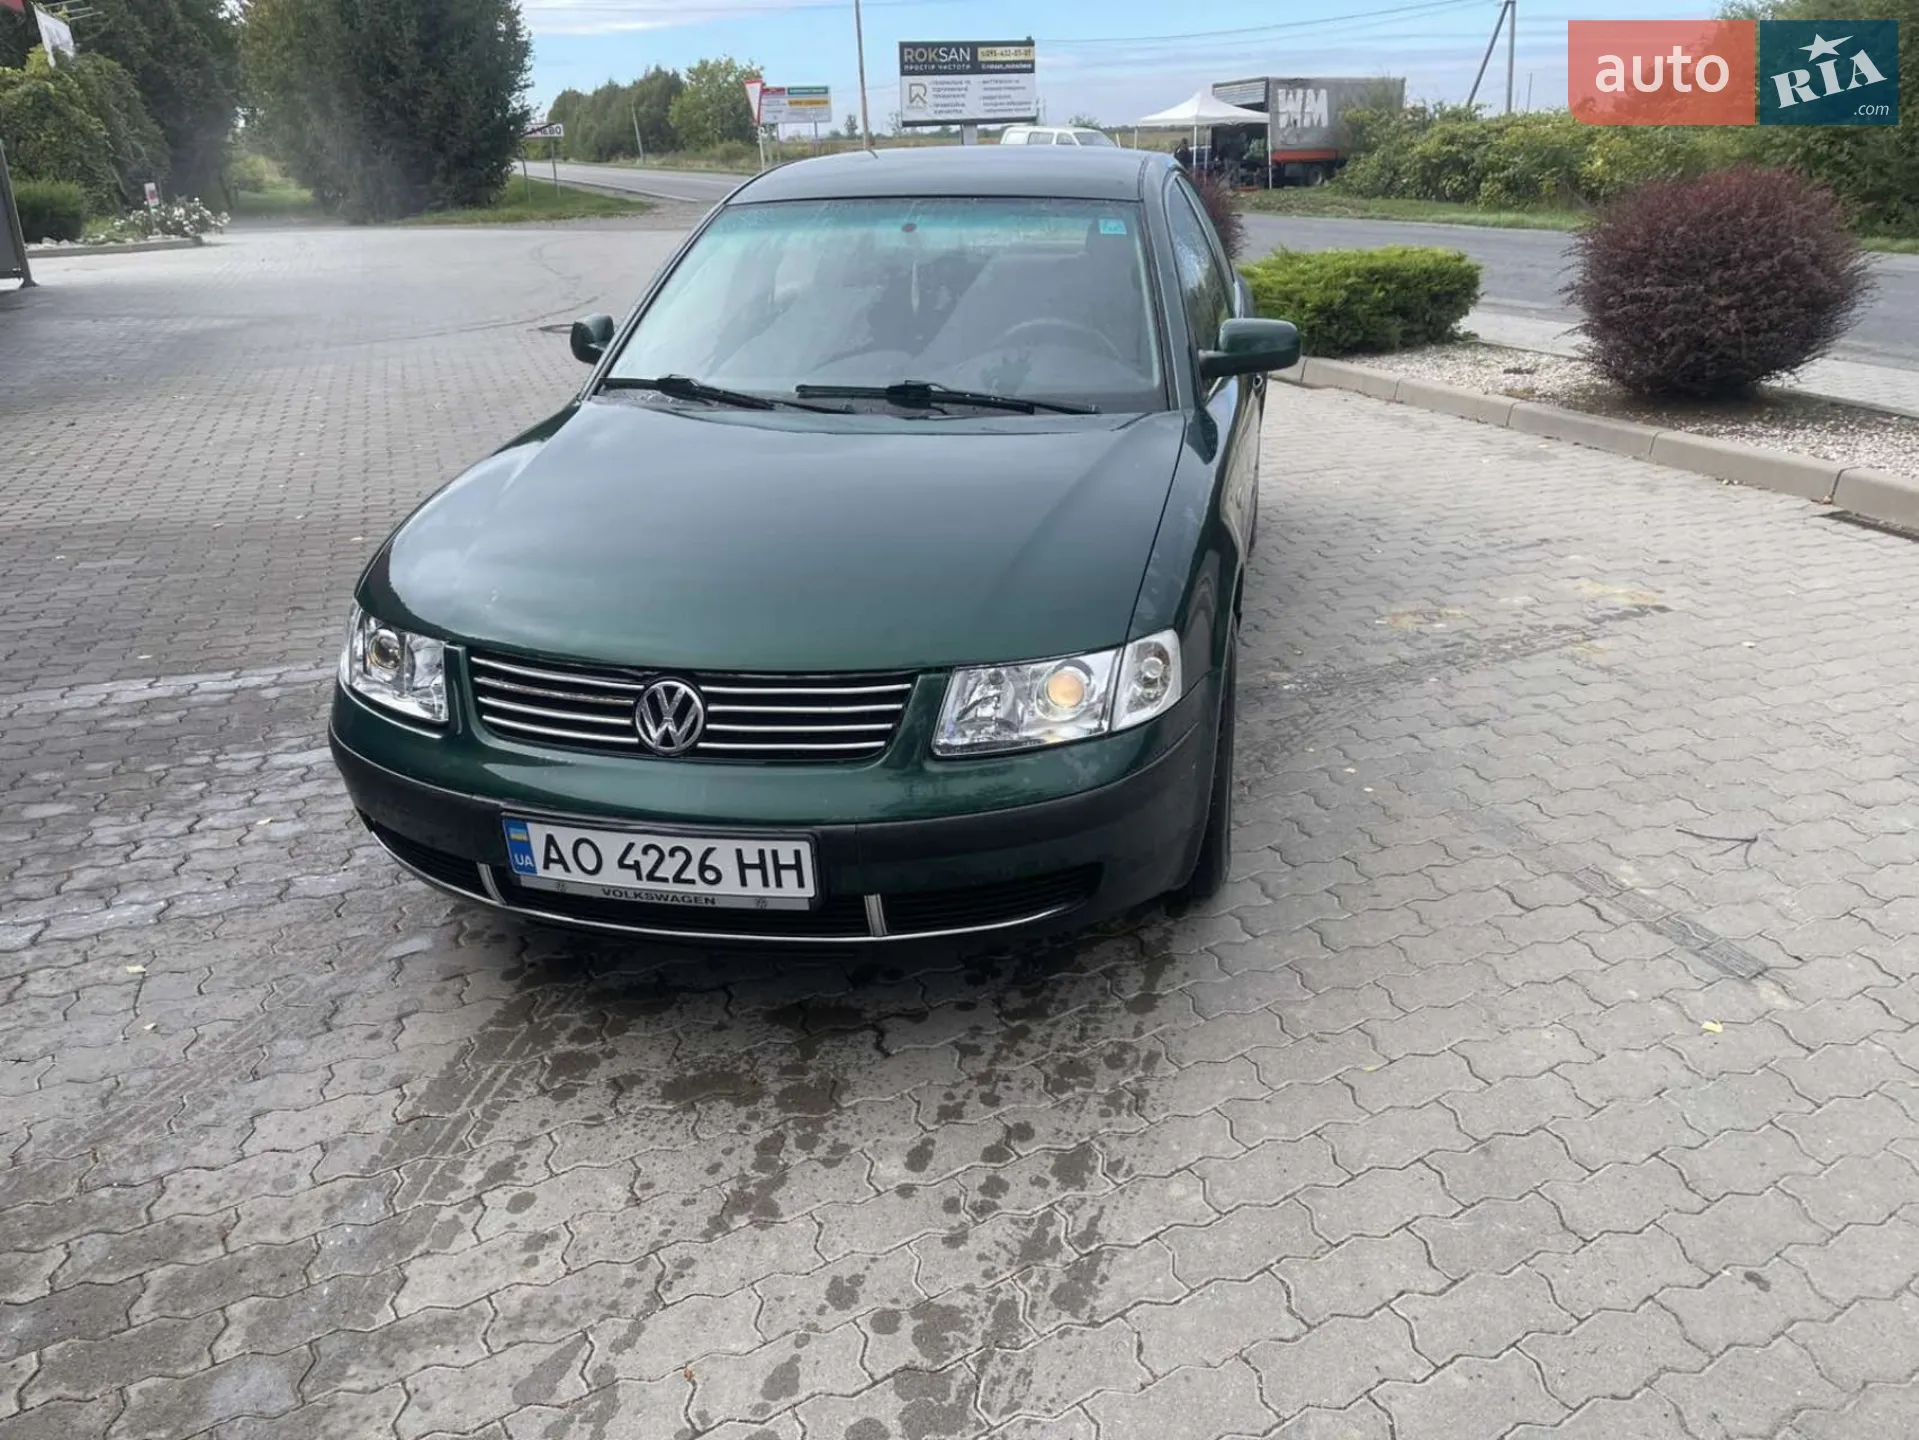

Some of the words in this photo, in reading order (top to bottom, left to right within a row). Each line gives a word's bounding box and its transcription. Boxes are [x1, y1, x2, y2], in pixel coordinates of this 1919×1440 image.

[904, 47, 970, 62] ROKSAN
[636, 681, 704, 753] VW
[514, 853, 534, 867] UA
[542, 833, 603, 876] AO
[617, 841, 723, 886] 4226
[735, 848, 806, 888] HH
[601, 888, 717, 905] VOLKSWAGEN
